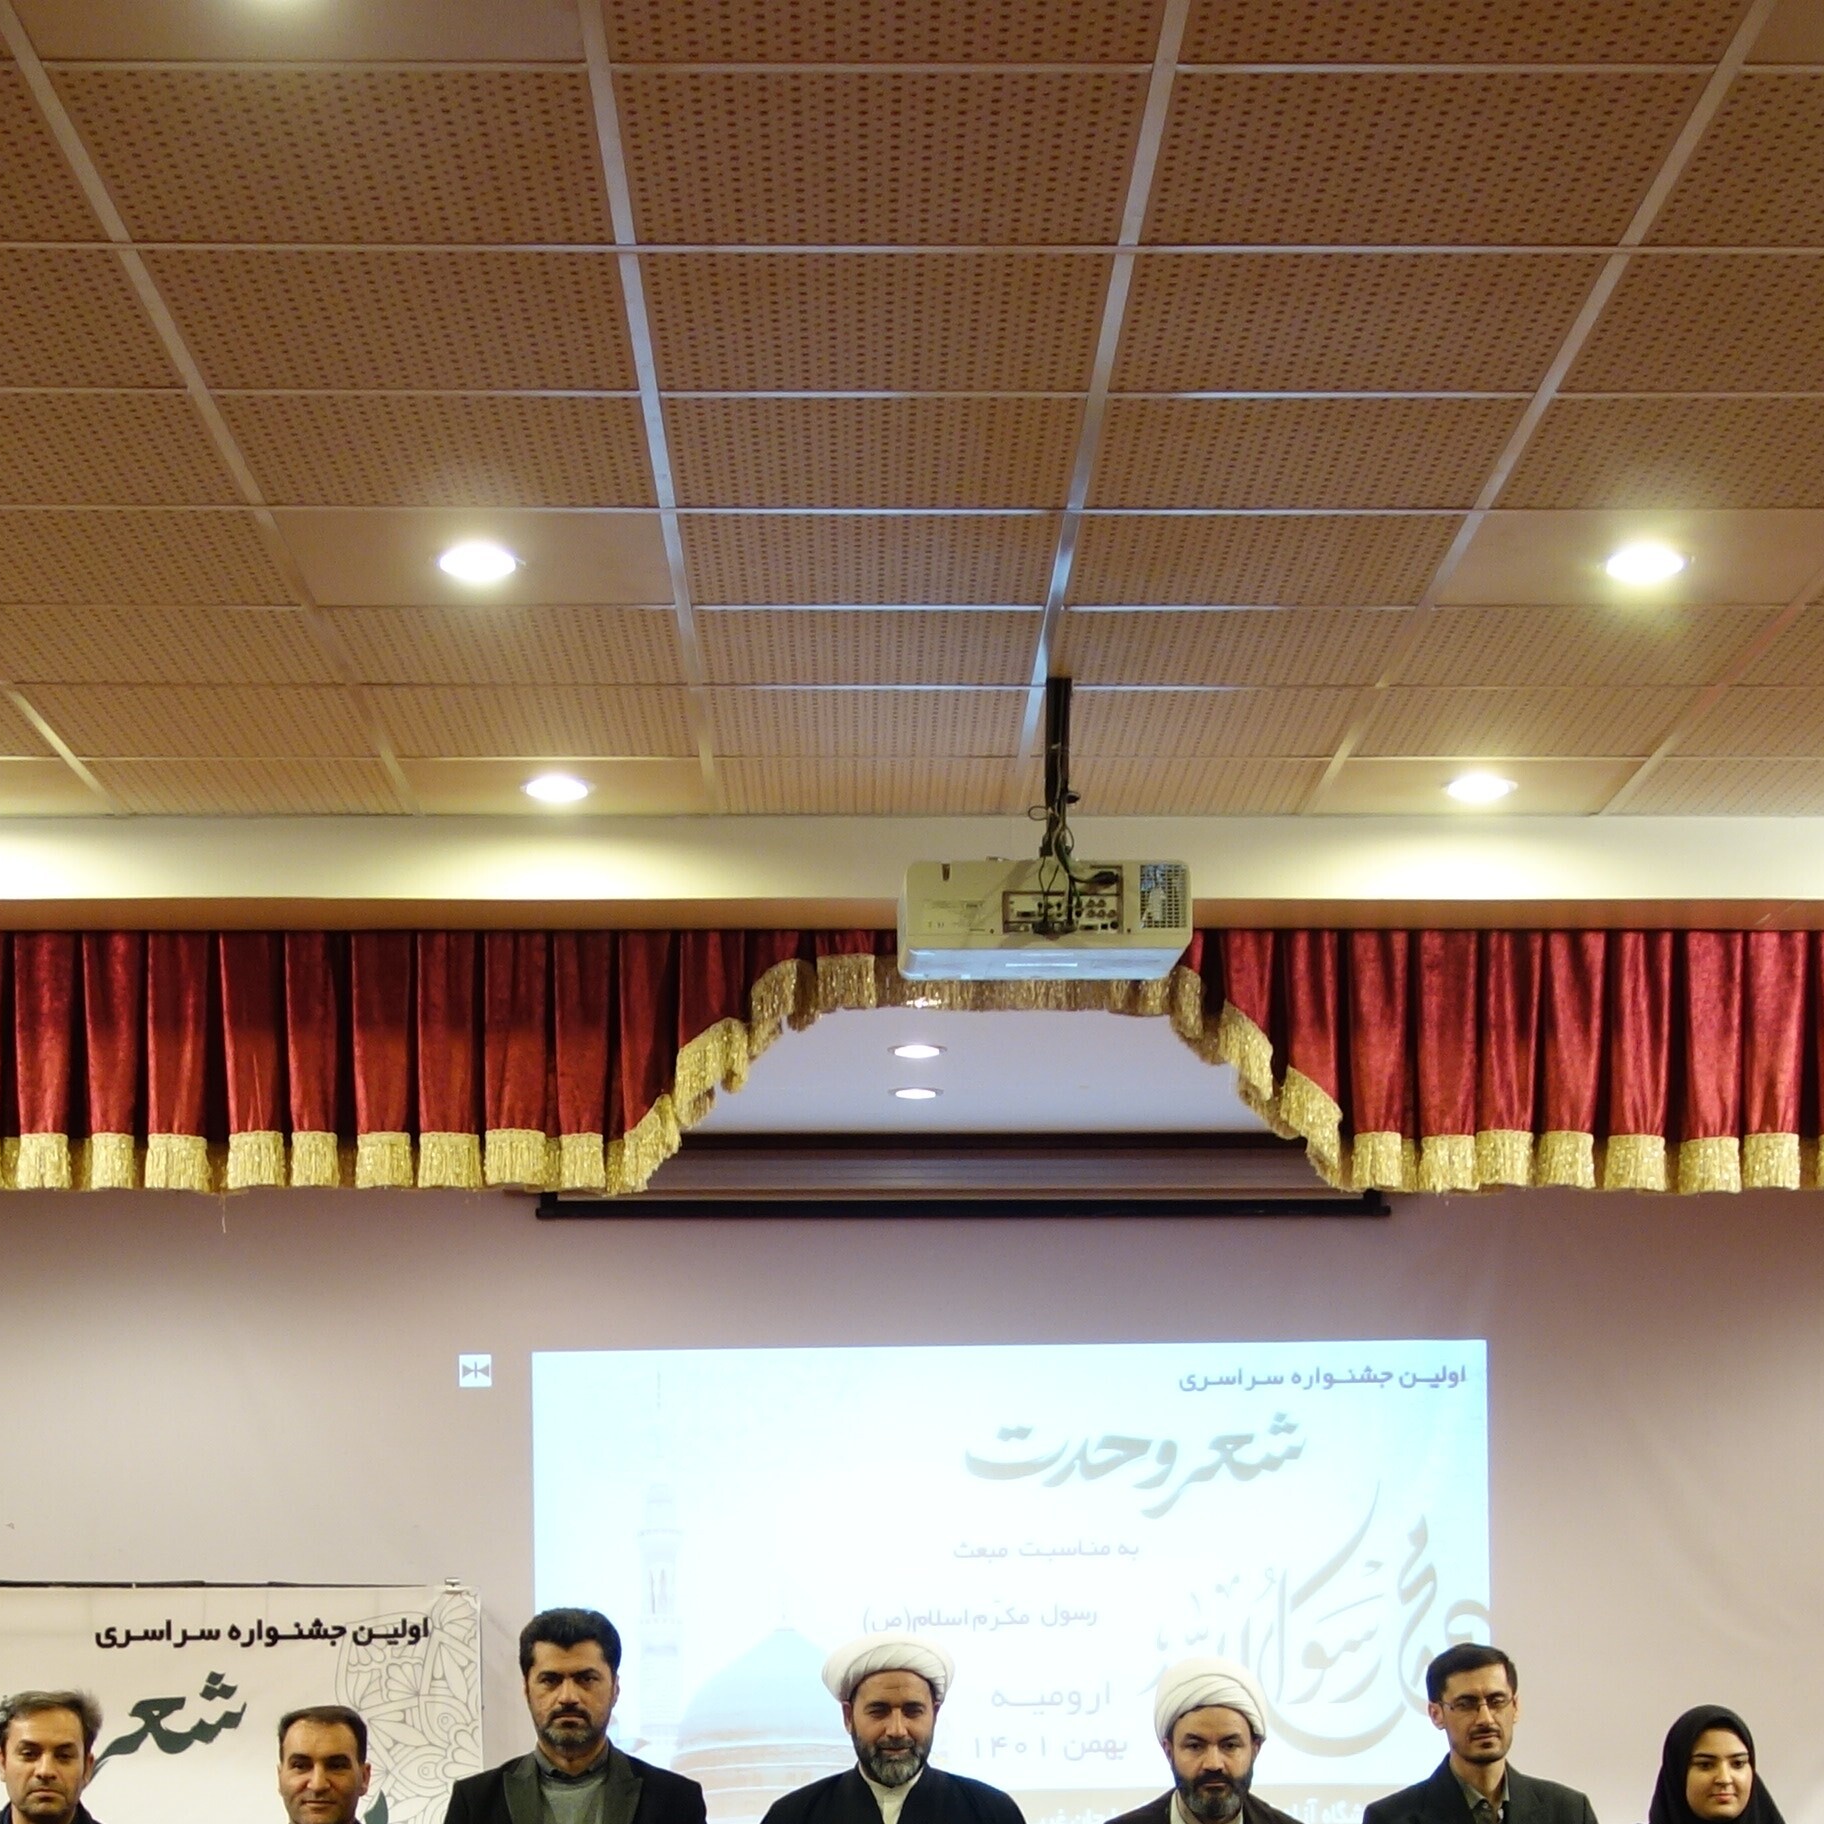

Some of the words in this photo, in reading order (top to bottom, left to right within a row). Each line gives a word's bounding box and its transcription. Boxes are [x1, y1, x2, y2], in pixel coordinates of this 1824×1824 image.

[1291, 1365, 1393, 1391] جشنواره
[1399, 1365, 1467, 1389] اولین
[965, 1425, 1178, 1489] وحدت
[1139, 1411, 1307, 1519] شعر
[1041, 1603, 1098, 1627] رسول
[227, 1618, 347, 1647] جشنواره
[351, 1617, 430, 1646] اولین
